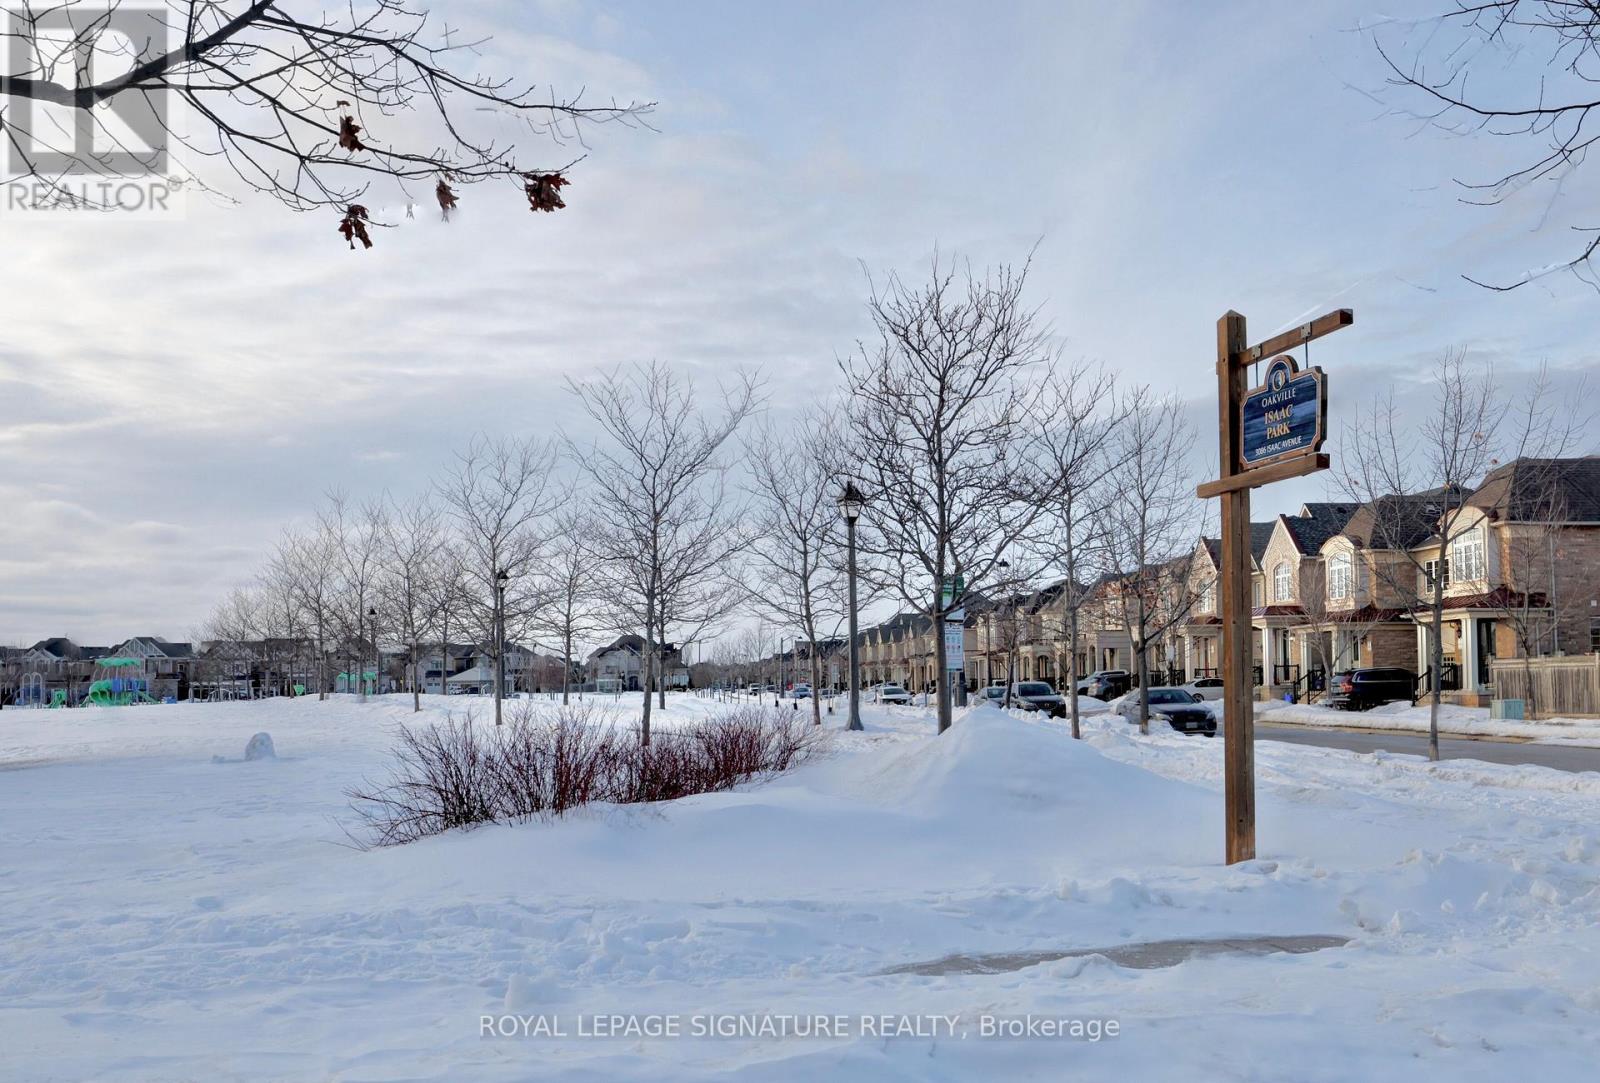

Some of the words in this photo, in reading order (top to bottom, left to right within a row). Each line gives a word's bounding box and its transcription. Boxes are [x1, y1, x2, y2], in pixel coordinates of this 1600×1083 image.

[1262, 388, 1296, 407] OAKVILLE
[1265, 405, 1293, 424] ISAAC
[1267, 423, 1290, 440] PARK
[1267, 442, 1281, 453] ISAAC
[1282, 436, 1302, 448] AVENUE
